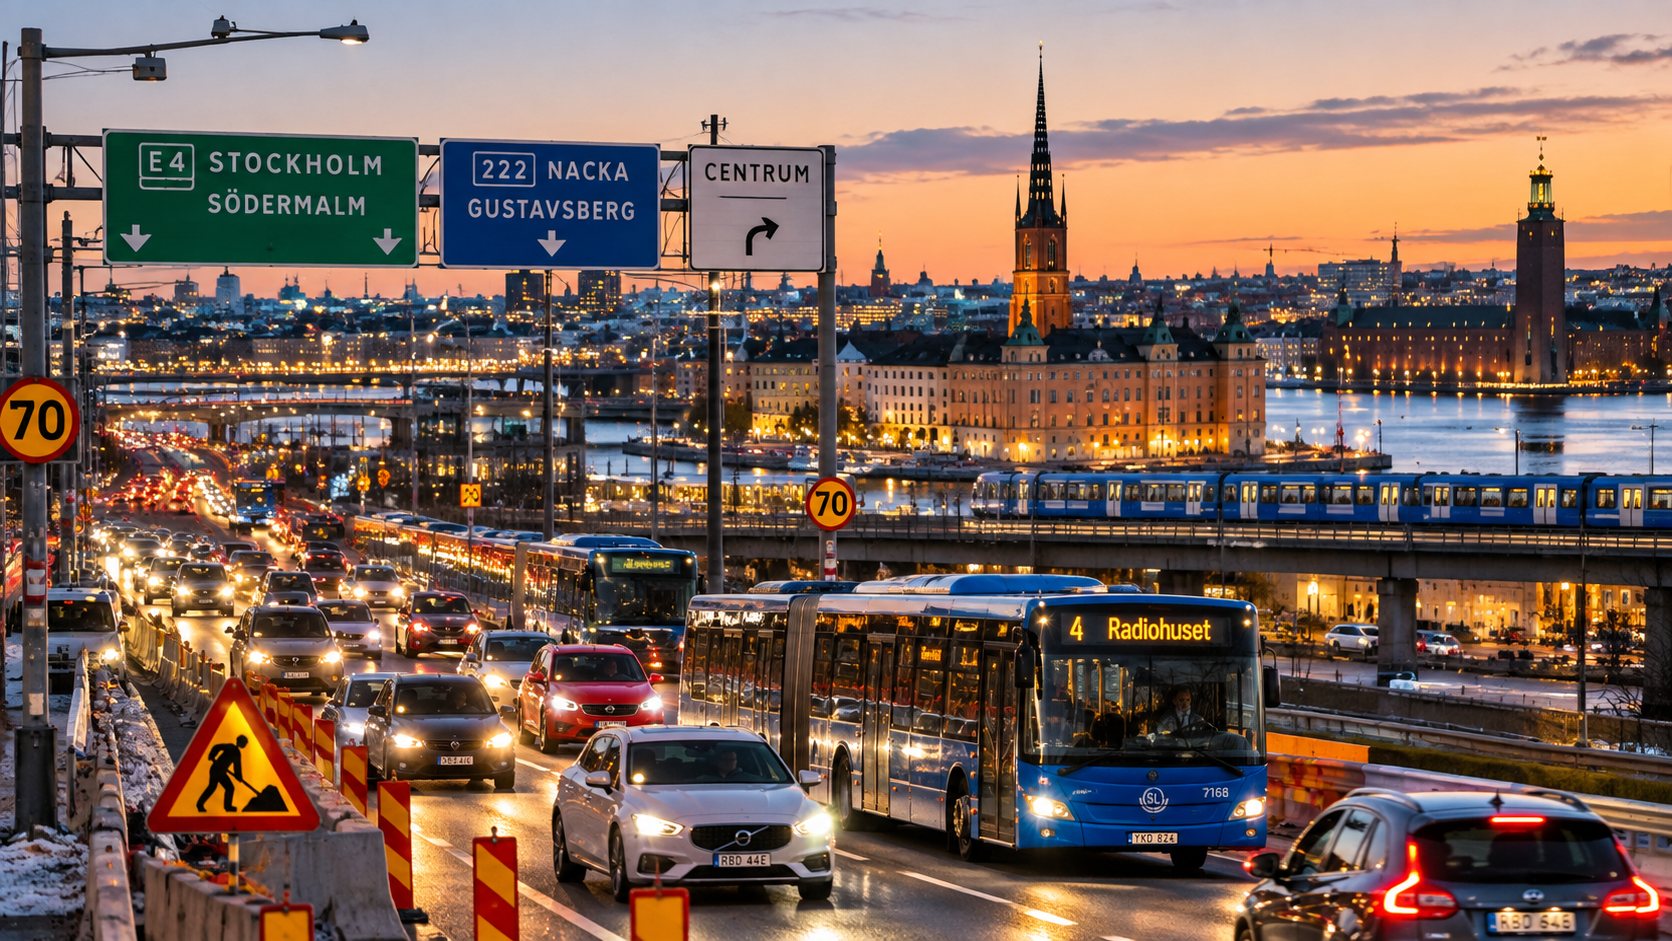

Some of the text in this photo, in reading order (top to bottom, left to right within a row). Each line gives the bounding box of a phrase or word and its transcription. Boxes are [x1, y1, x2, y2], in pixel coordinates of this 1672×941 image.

[209, 151, 382, 176] STOCKHOLM
[481, 159, 629, 182] 222 NACKA
[704, 162, 810, 184] CENTRUM
[208, 188, 366, 216] SÖDERMALM
[468, 198, 635, 221] GUSTAVSBERG
[10, 400, 65, 440] 70
[815, 491, 848, 516] 70
[1069, 616, 1212, 642] 4 Radiohuset
[1146, 792, 1161, 805] SL
